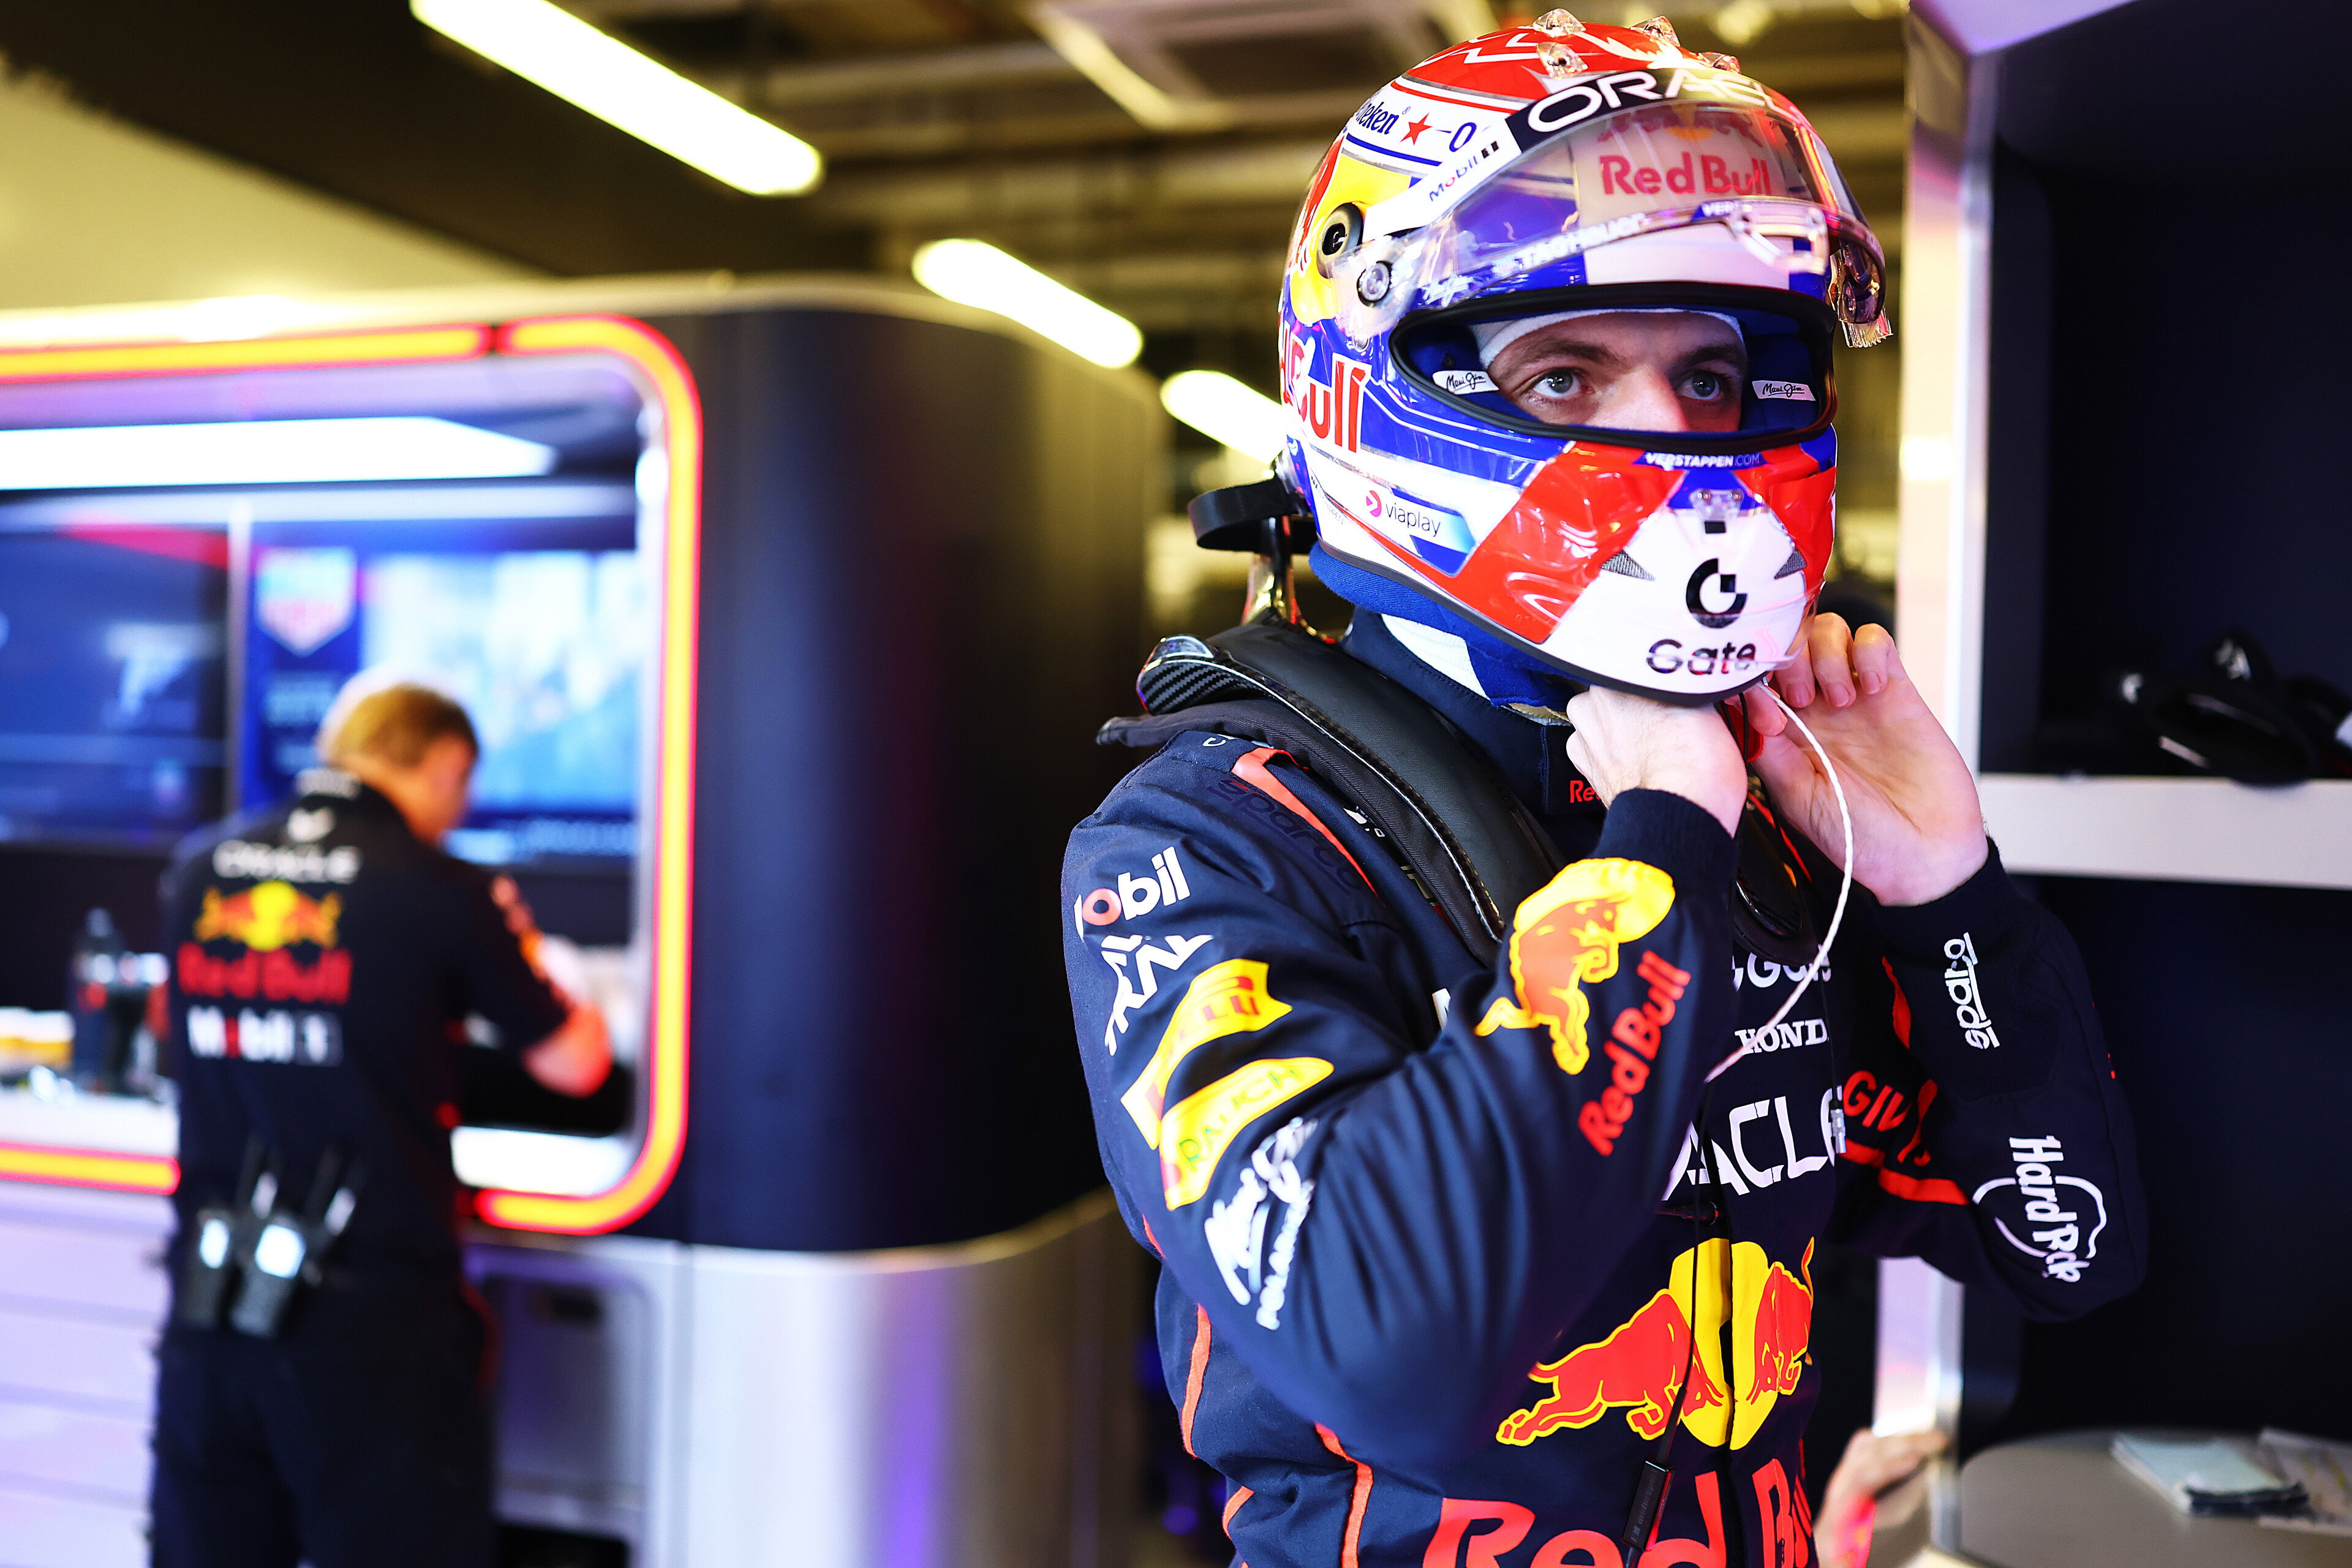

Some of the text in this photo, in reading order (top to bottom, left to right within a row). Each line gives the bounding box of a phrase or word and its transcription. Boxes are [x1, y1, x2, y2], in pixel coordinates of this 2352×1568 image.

[1429, 155, 1478, 202] Mobil
[1599, 151, 1773, 197] Red Bull
[1446, 372, 1485, 390] Maui Jim
[1762, 383, 1804, 398] Maui Jim
[1385, 502, 1441, 537] viaplay
[1646, 639, 1757, 676] Gate
[1570, 780, 1601, 803] Re
[1074, 846, 1191, 942] obil
[1578, 949, 1692, 1156] Red Bull
[1734, 1018, 1829, 1055] HOND
[2009, 1135, 2077, 1223] Hard
